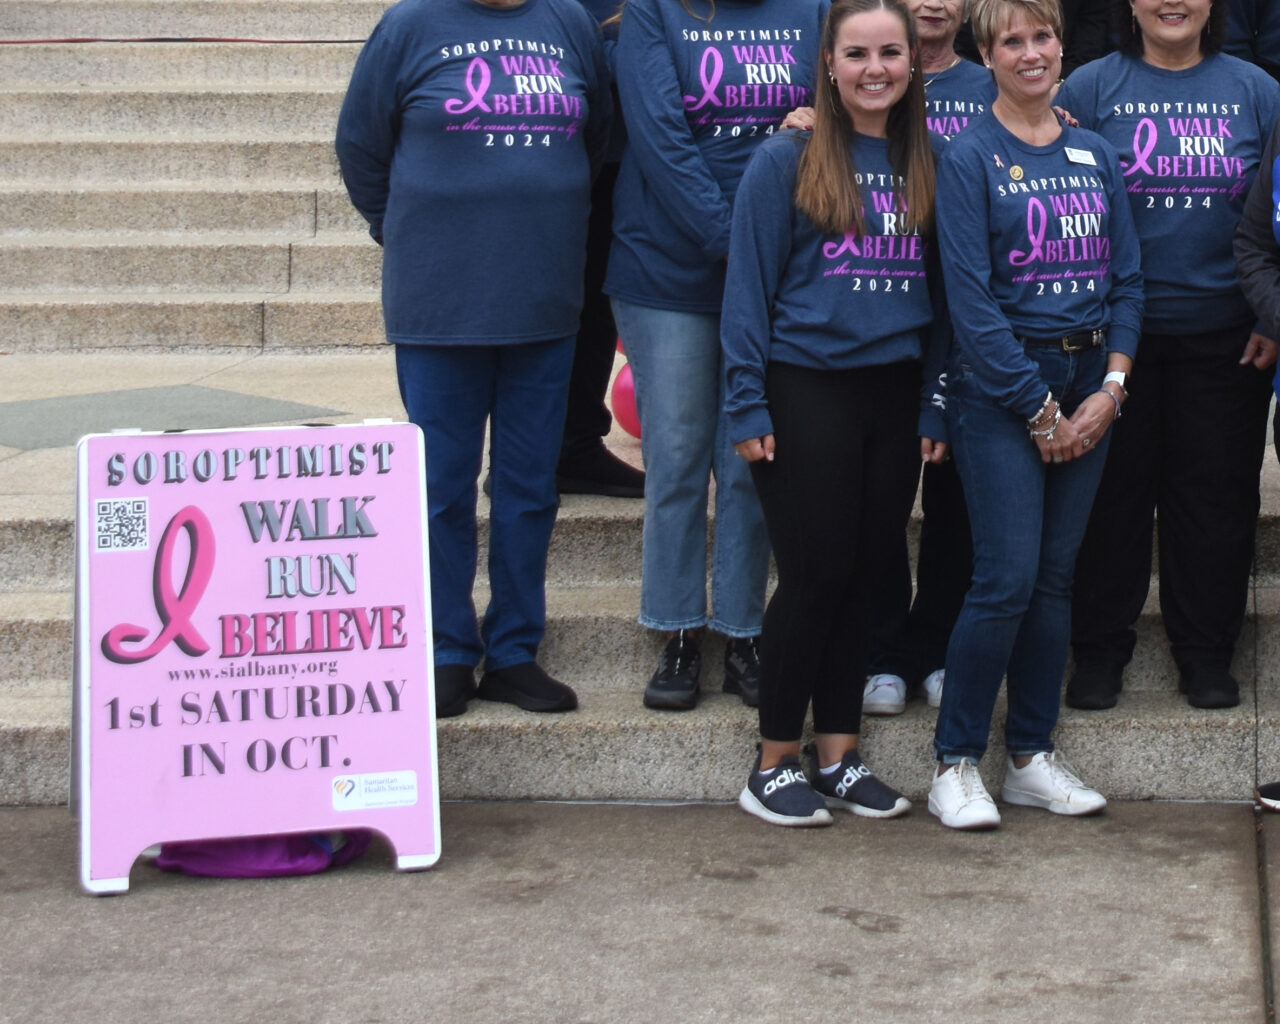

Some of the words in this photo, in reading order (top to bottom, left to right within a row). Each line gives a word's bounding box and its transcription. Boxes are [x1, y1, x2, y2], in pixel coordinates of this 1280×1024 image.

[683, 29, 801, 41] SOROPTIMIST
[441, 39, 565, 59] SOROPTIMIST
[732, 44, 797, 64] WALK
[499, 55, 566, 78] WALK
[745, 64, 792, 84] RUN
[514, 75, 563, 94] RUN
[493, 94, 582, 119] BELIEVE
[1114, 102, 1240, 116] SOROPTIMIST
[462, 117, 481, 131] the
[518, 123, 529, 131] to
[714, 125, 774, 136] 2024
[1168, 117, 1233, 138] WALK
[485, 134, 550, 147] 2024
[1179, 137, 1224, 156] RUN
[1157, 155, 1246, 179] BELIEVE
[1127, 179, 1143, 193] the
[1179, 185, 1190, 193] to
[1048, 192, 1106, 217] WALK
[1146, 196, 1211, 208] 2024
[1059, 213, 1102, 239] RUN
[863, 235, 922, 261] BELIE
[833, 260, 851, 275] the
[853, 278, 910, 292] 2024
[1037, 279, 1095, 296] 2024
[107, 441, 395, 486] SOROPTIMIST
[239, 495, 378, 543] WALK
[264, 552, 358, 599] RUN
[218, 604, 408, 659] BELIEVE
[167, 659, 339, 682] www.sialbany.org
[104, 696, 162, 730] 1st
[180, 680, 407, 726] SATURDAY
[180, 742, 226, 778] IN
[246, 734, 353, 774] OCT.
